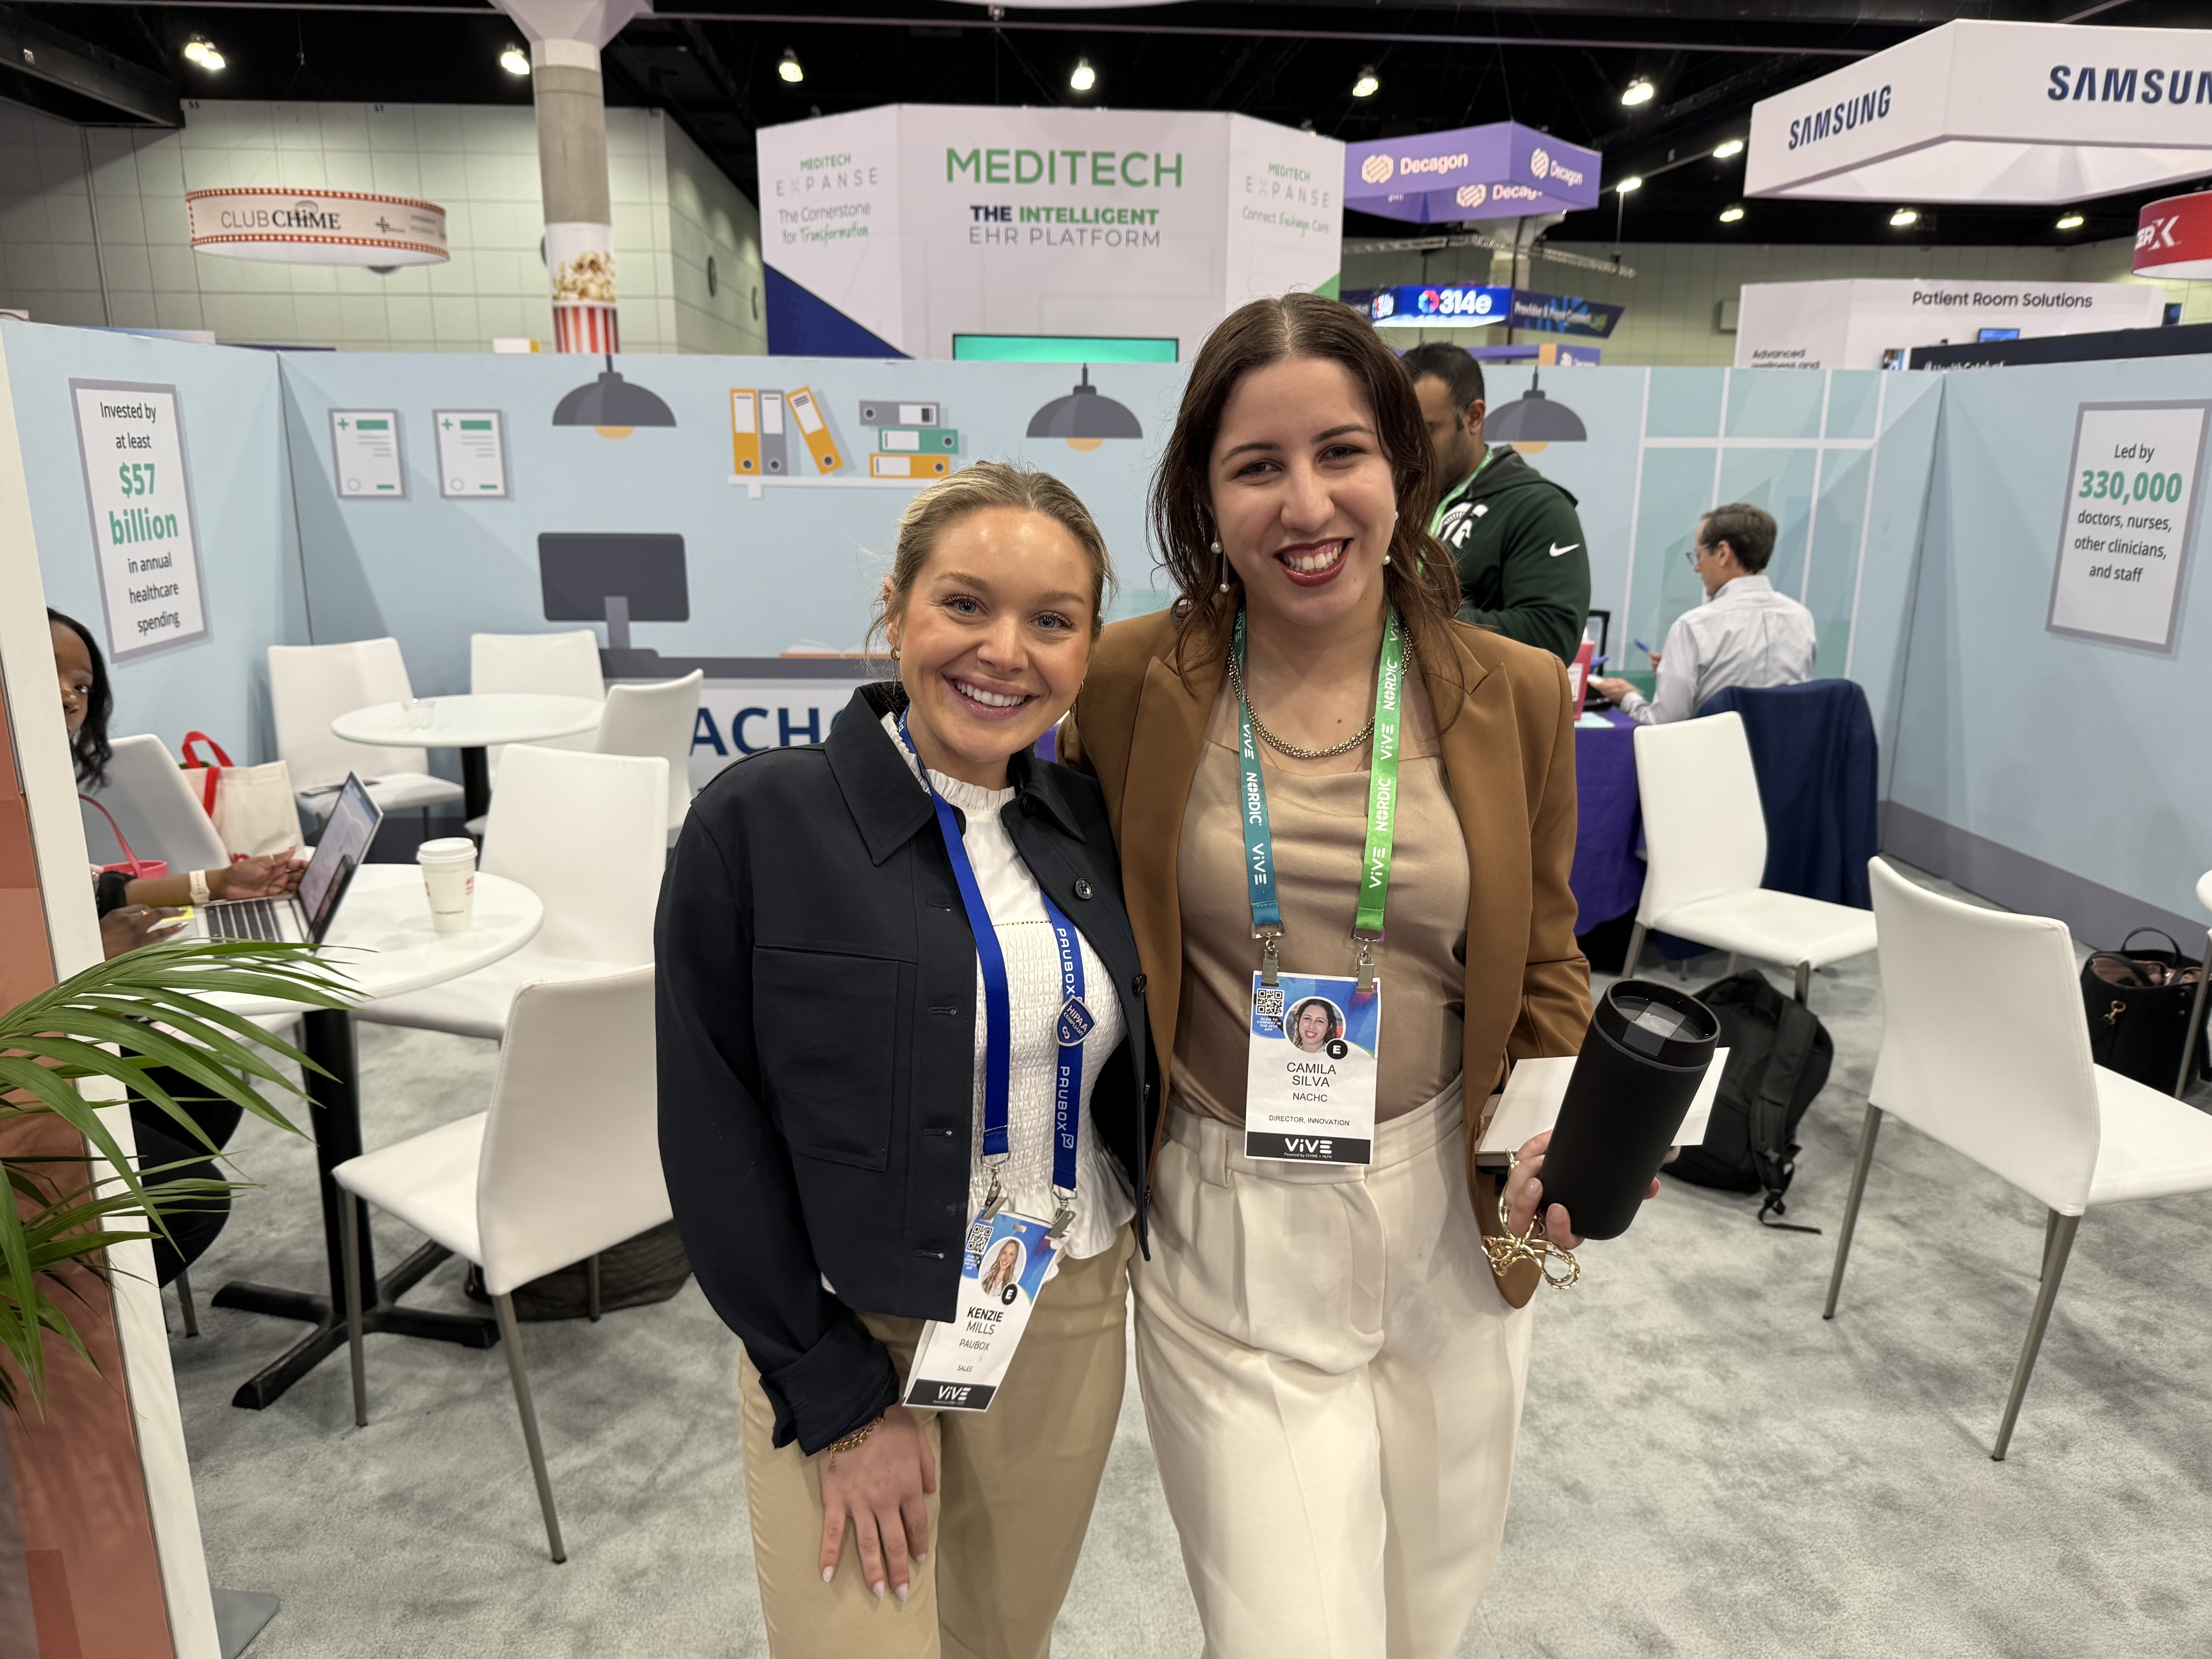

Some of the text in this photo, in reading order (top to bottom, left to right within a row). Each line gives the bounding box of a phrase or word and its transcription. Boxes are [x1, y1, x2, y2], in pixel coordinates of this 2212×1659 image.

[1788, 84, 1892, 150] SAMSUNG
[800, 153, 852, 172] MEDITECH
[946, 148, 1182, 188] MEDITECH
[1400, 154, 1468, 176] Decagon
[776, 167, 878, 197] EXPANSE
[1245, 175, 1330, 209] EXPANSE
[220, 210, 270, 228] CLUB
[778, 202, 871, 224] The Cornerstone
[970, 205, 1159, 225] THE INTELLIGENT
[782, 230, 797, 244] for
[969, 226, 1160, 248] EHR PLATFORM
[1439, 290, 1492, 314] 314e
[1912, 290, 2093, 307] Patient Room Solutions
[100, 401, 156, 423] Invested by
[115, 432, 151, 449] at least
[2114, 443, 2155, 463] Led by
[119, 462, 156, 499] $57
[2078, 469, 2183, 505] 330,000
[109, 507, 179, 545] billion
[2078, 510, 2172, 532] doctors, nurses,
[2074, 536, 2167, 560] other clinicians,
[128, 552, 173, 574] in annual
[2089, 564, 2143, 583] and staff
[129, 581, 179, 604] healthcare
[137, 610, 180, 636] spending
[1383, 658, 1397, 710] NORDIC
[1246, 771, 1262, 825] NORDIC
[1375, 778, 1391, 832] NORDIC
[1057, 928, 1075, 994] PAUBOX
[1063, 1012, 1084, 1036] COMPLIANT
[1067, 1005, 1087, 1032] HIPAA
[1333, 1046, 1341, 1054] E
[1287, 1062, 1336, 1075] CAMILA
[1292, 1075, 1330, 1087] SILVA
[1057, 1066, 1070, 1131] PAUBOX
[1293, 1092, 1328, 1103] NACHC
[1269, 1115, 1350, 1126] DIRECTOR, INNOVATION
[1005, 1289, 1014, 1300] E
[967, 1306, 1004, 1322] KENZIE
[966, 1321, 996, 1335] MILLS
[959, 1339, 990, 1351] PAUBOX
